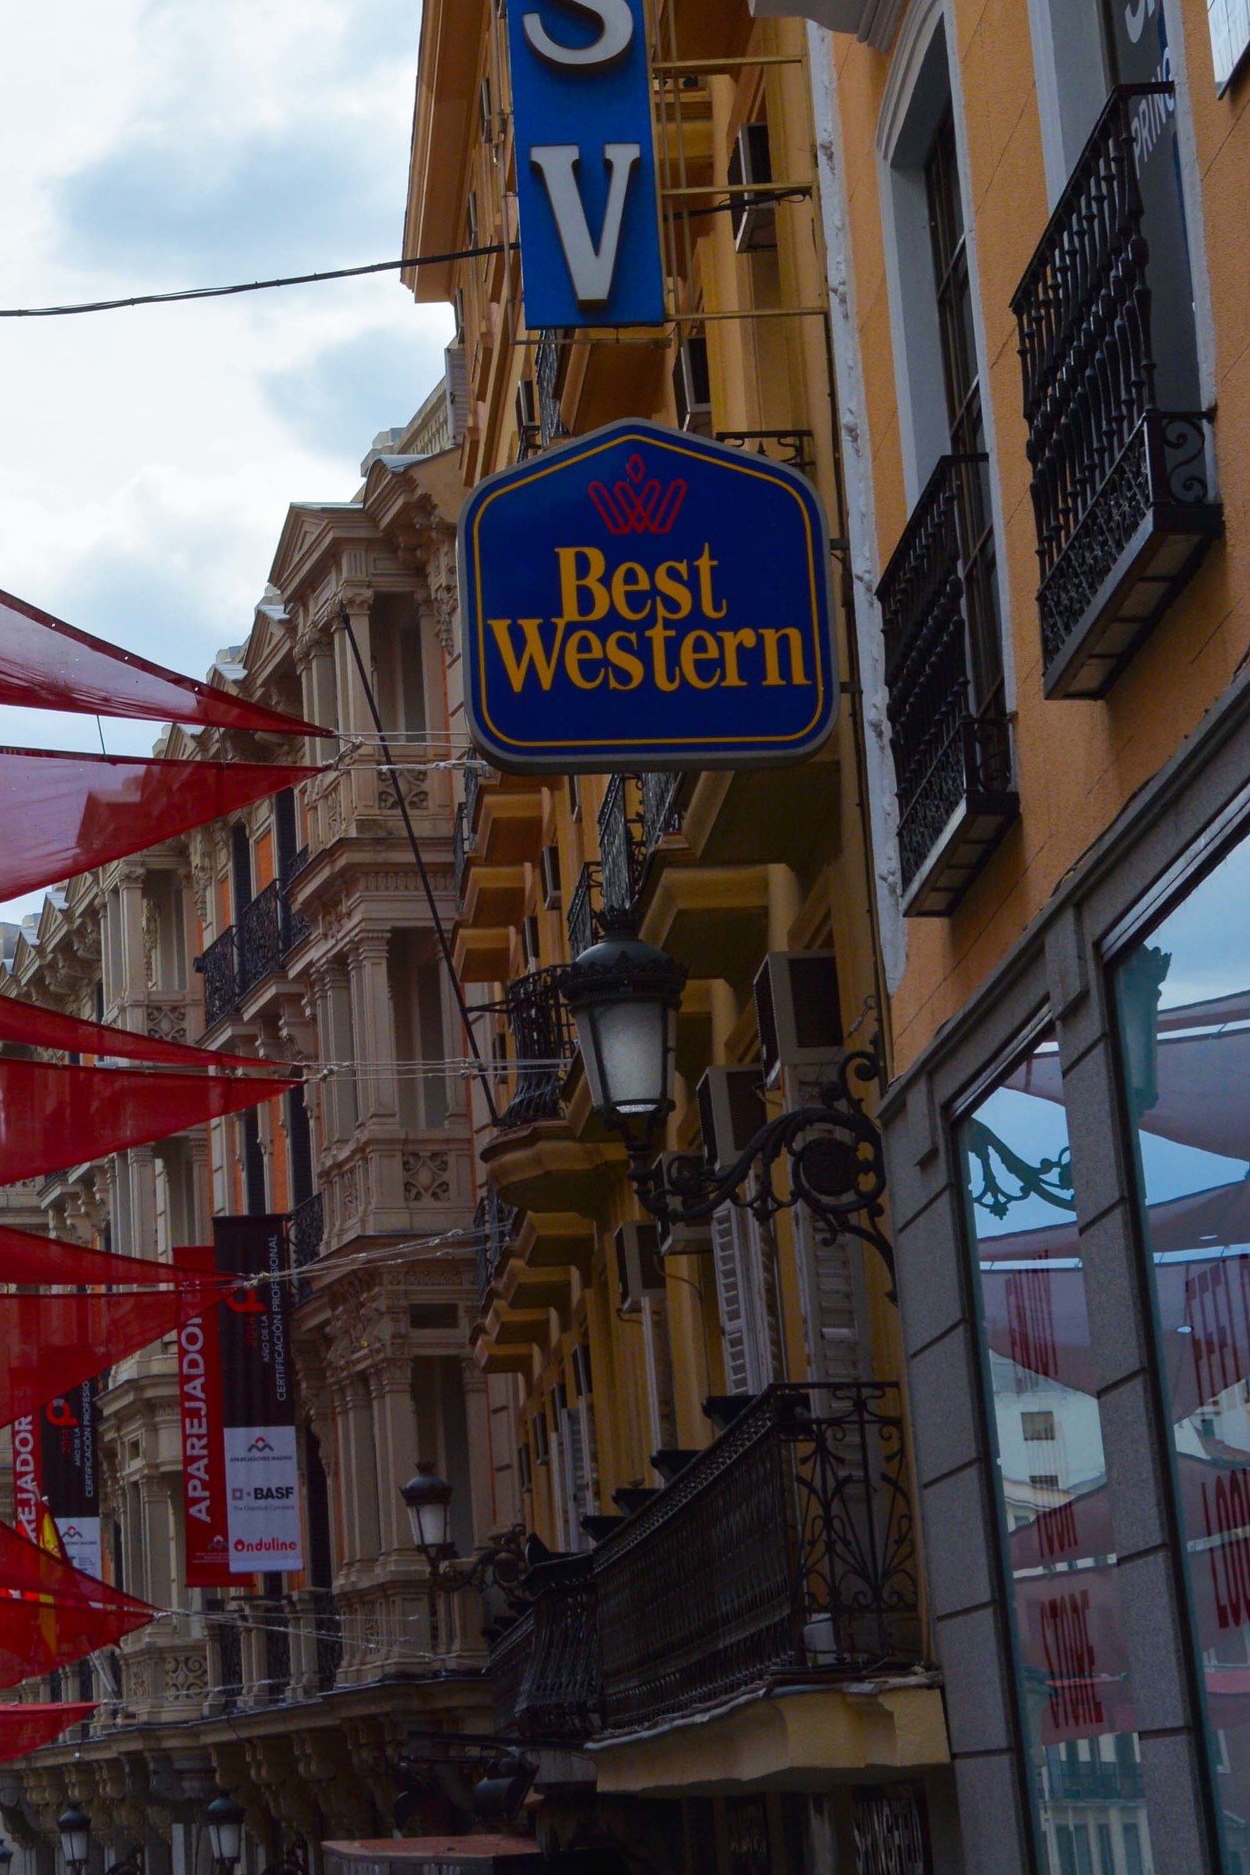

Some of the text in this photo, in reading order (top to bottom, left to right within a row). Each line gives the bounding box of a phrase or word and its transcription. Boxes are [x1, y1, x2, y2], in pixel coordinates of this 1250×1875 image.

[529, 140, 642, 312] V
[554, 542, 728, 623] Best
[486, 596, 813, 694] Western
[260, 1314, 271, 1363] AÑO DE LA
[270, 1314, 287, 1402] CERTIFICACIÓN
[72, 1427, 81, 1467] AÑO DE LA
[83, 1427, 94, 1498] CERTIFICACIÓN
[253, 1486, 295, 1501] BASF
[234, 1537, 298, 1553] Onduline
[1039, 1588, 1104, 1730] STORE
